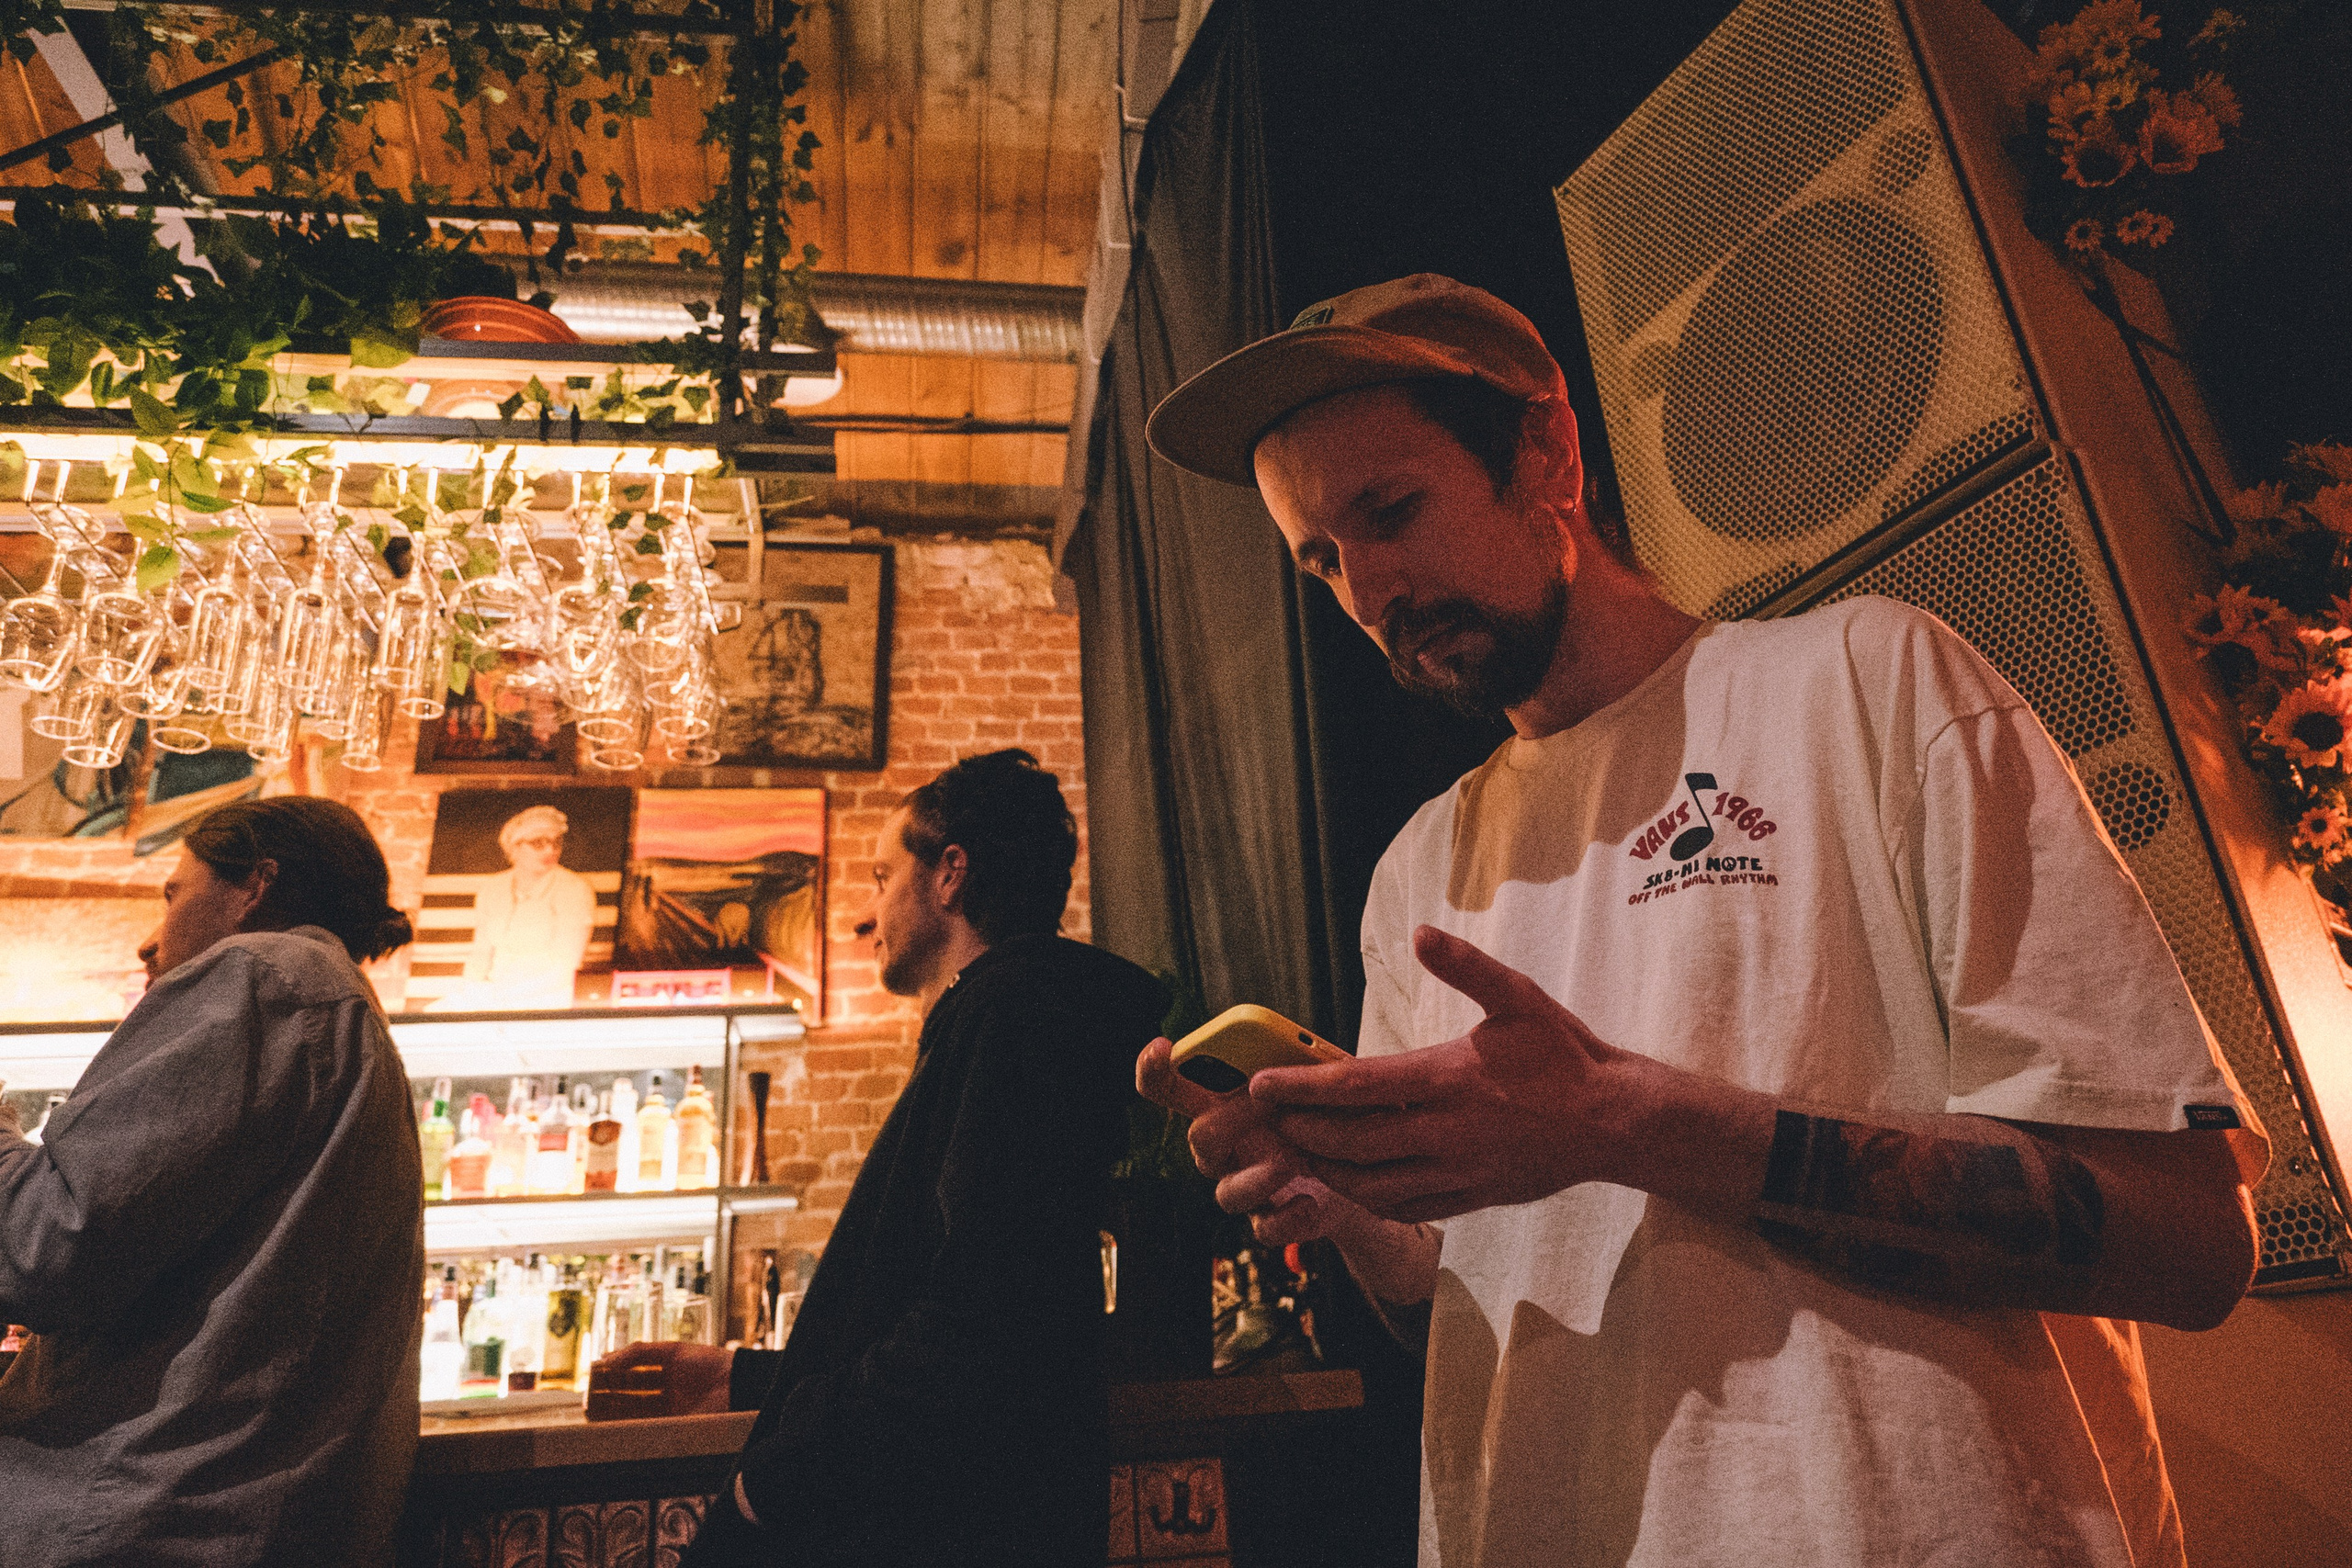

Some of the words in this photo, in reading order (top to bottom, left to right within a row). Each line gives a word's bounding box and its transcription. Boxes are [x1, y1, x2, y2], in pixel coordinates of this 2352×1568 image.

[1629, 800, 1690, 860] VANS
[1712, 792, 1778, 841] 1966
[1628, 892, 1652, 906] OFF
[1655, 883, 1678, 899] THE
[1681, 874, 1715, 890] WALL
[1720, 873, 1779, 886] RHYTHM
[1643, 859, 1700, 890] SK8-HI
[1706, 856, 1763, 872] NOTE
